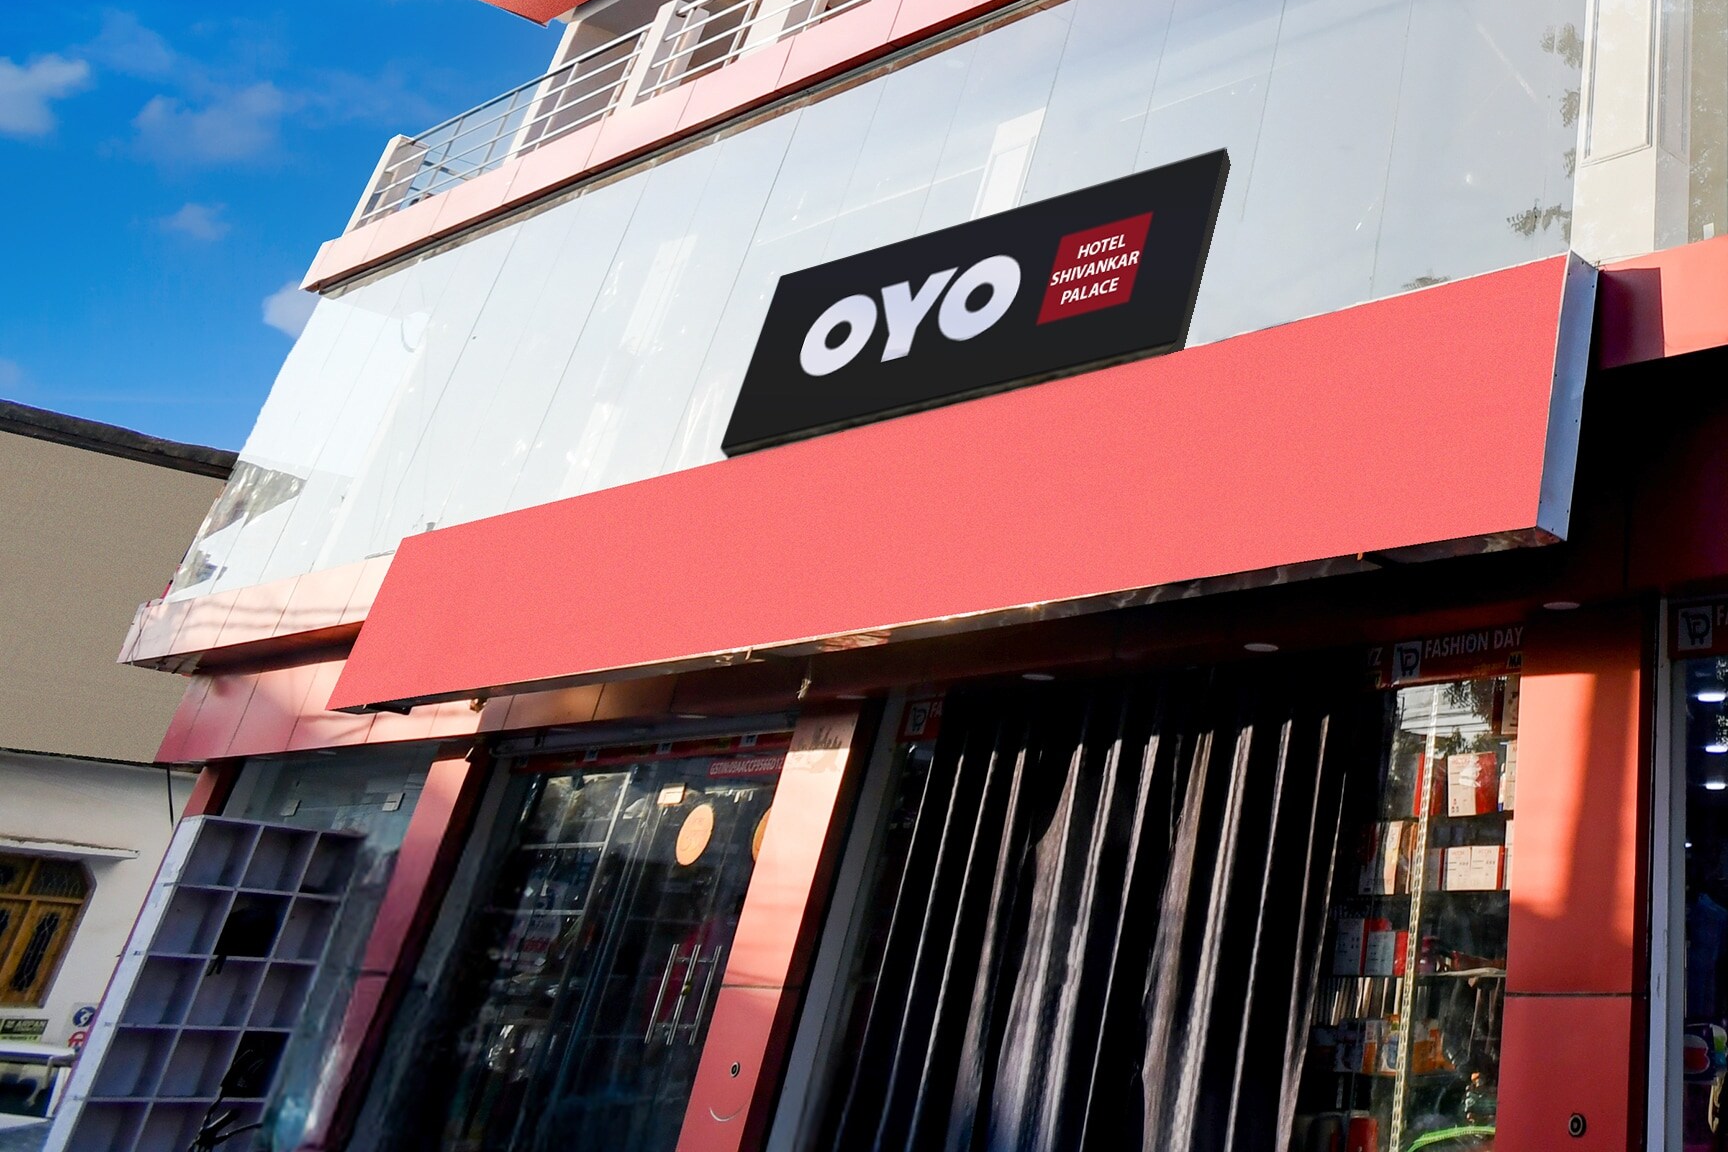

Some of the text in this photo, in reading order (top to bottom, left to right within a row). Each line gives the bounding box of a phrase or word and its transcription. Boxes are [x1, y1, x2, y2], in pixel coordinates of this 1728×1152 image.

[1077, 234, 1126, 259] HOTEL
[1050, 250, 1140, 286] SHIVANKAR
[1060, 277, 1118, 305] PALACE
[800, 255, 1021, 376] OYO
[1425, 626, 1523, 659] FASHION DAY
